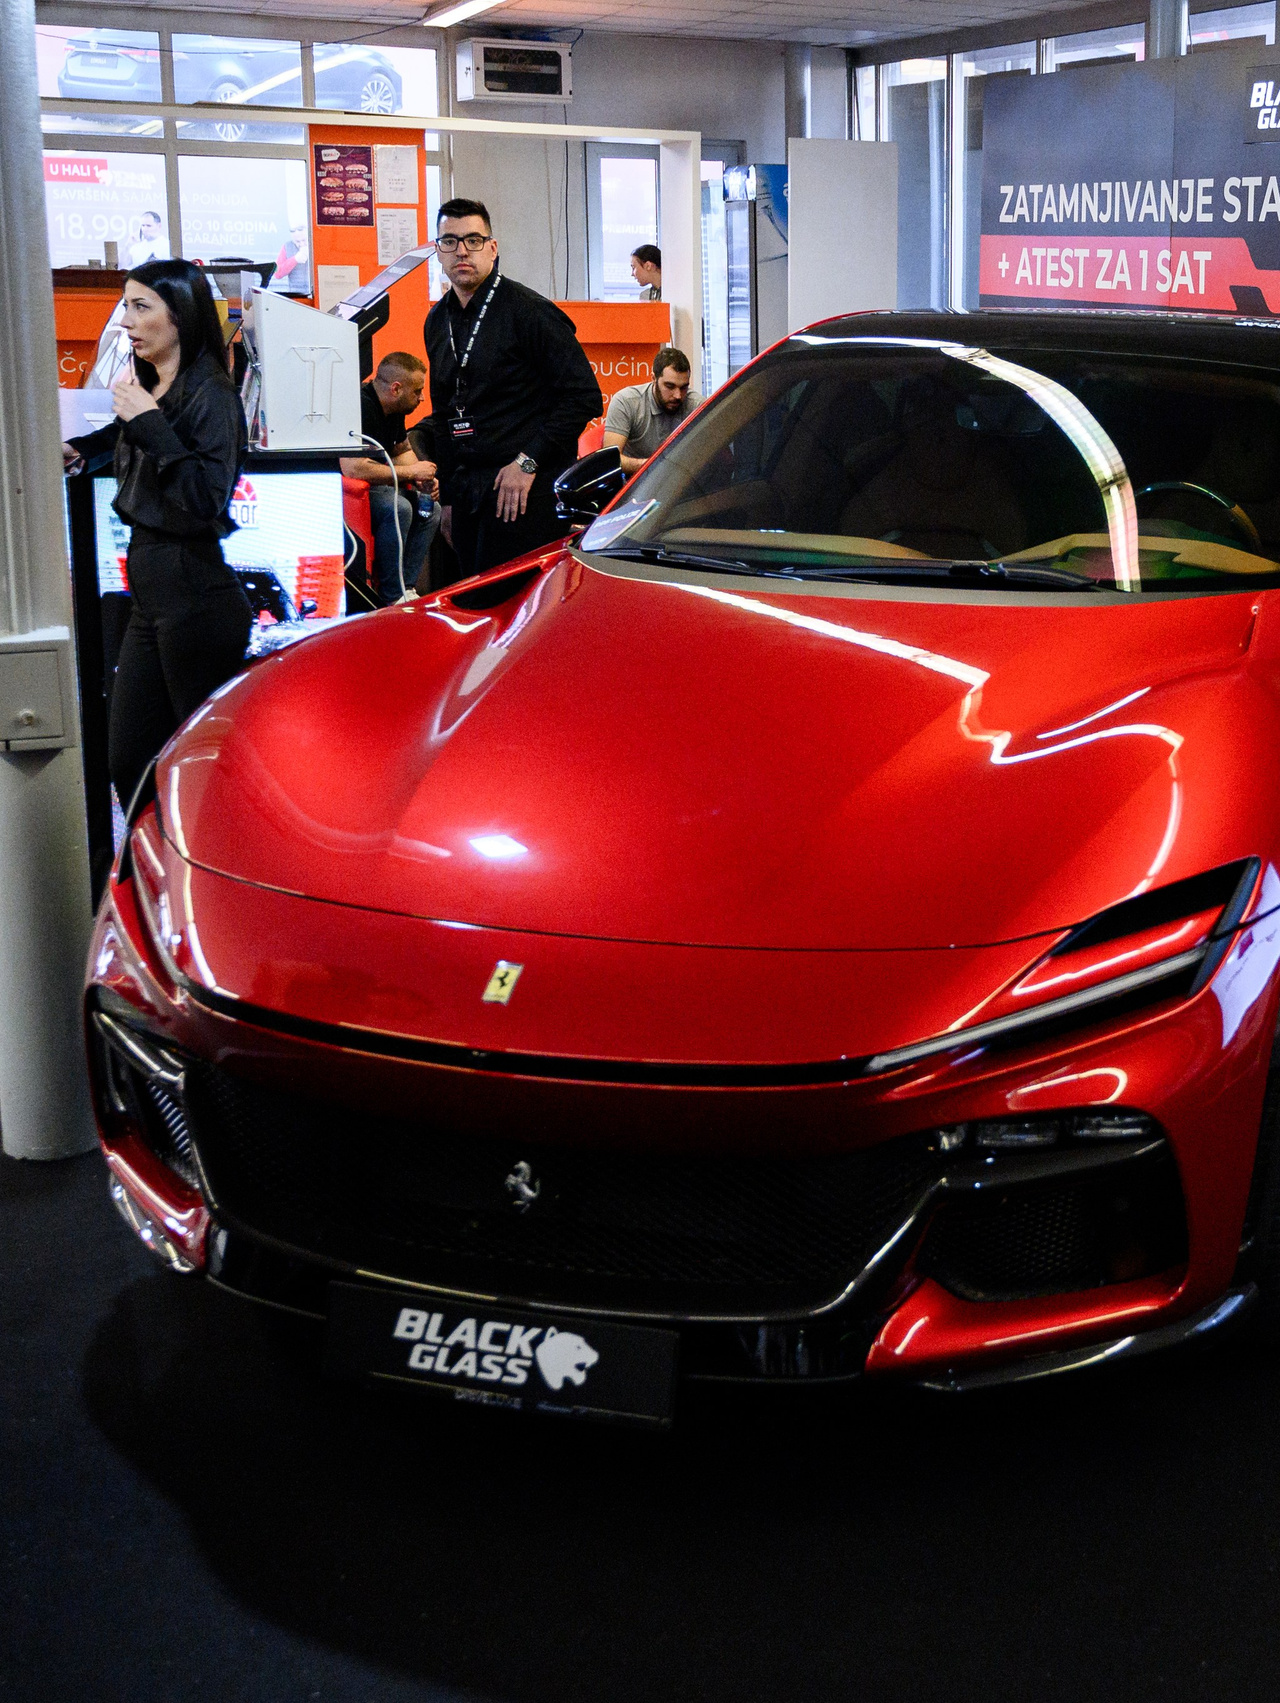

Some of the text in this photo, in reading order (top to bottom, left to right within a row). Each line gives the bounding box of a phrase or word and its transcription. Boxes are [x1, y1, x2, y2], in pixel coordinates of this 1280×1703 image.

[49, 163, 59, 175] U
[62, 164, 90, 177] HALI
[52, 188, 119, 203] SAVRŠENA
[193, 193, 249, 207] PONUDA
[999, 178, 1214, 223] ZATAMNJIVANJE
[182, 219, 278, 234] DO 10 GODINA
[183, 232, 255, 246] GARANCIJE
[1015, 247, 1088, 288] ATEST
[1096, 248, 1132, 291] ZA
[1139, 249, 1148, 293] 1
[1156, 249, 1213, 295] SAT
[393, 1307, 542, 1358] BLACK
[408, 1342, 532, 1385] GLASS
